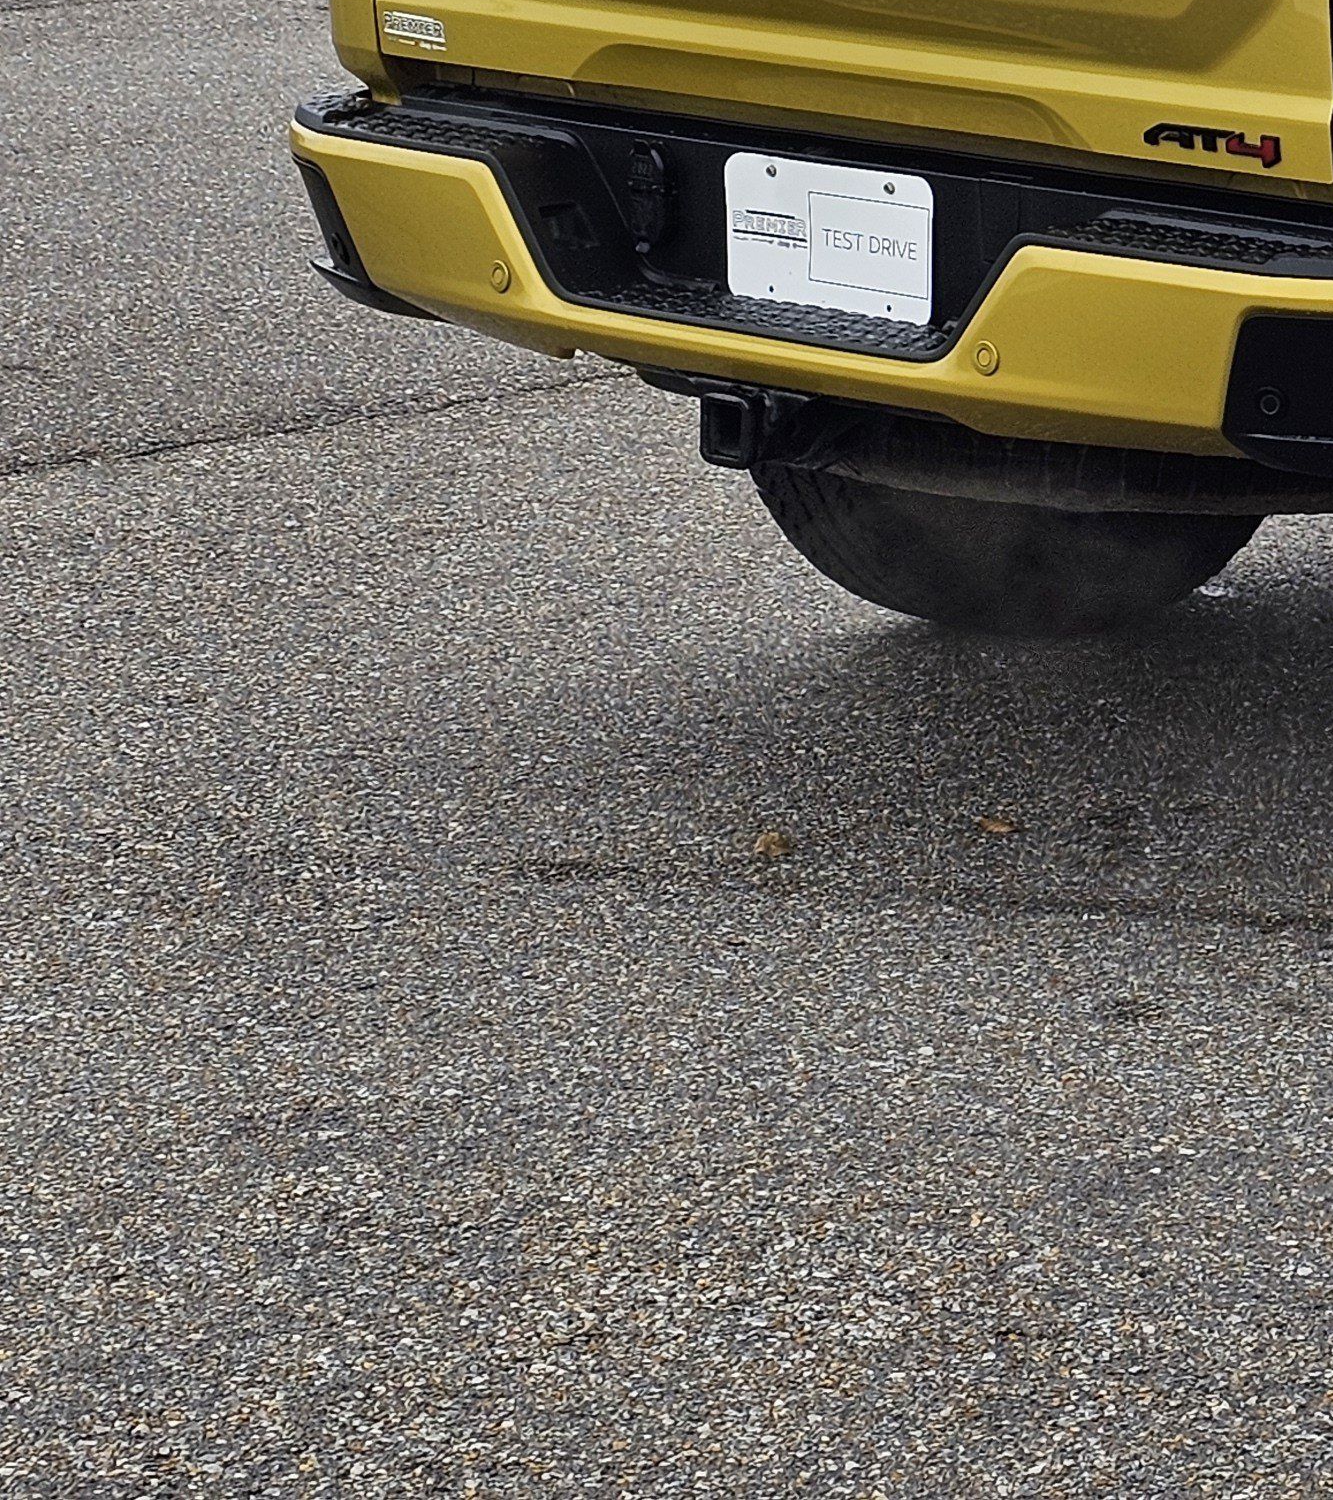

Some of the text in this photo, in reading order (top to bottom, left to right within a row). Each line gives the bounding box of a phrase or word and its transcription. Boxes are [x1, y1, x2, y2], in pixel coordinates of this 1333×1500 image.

[1143, 122, 1282, 169] AT4
[733, 210, 808, 238] PREMIER
[821, 228, 864, 251] TEST
[868, 236, 918, 260] DRIVE
